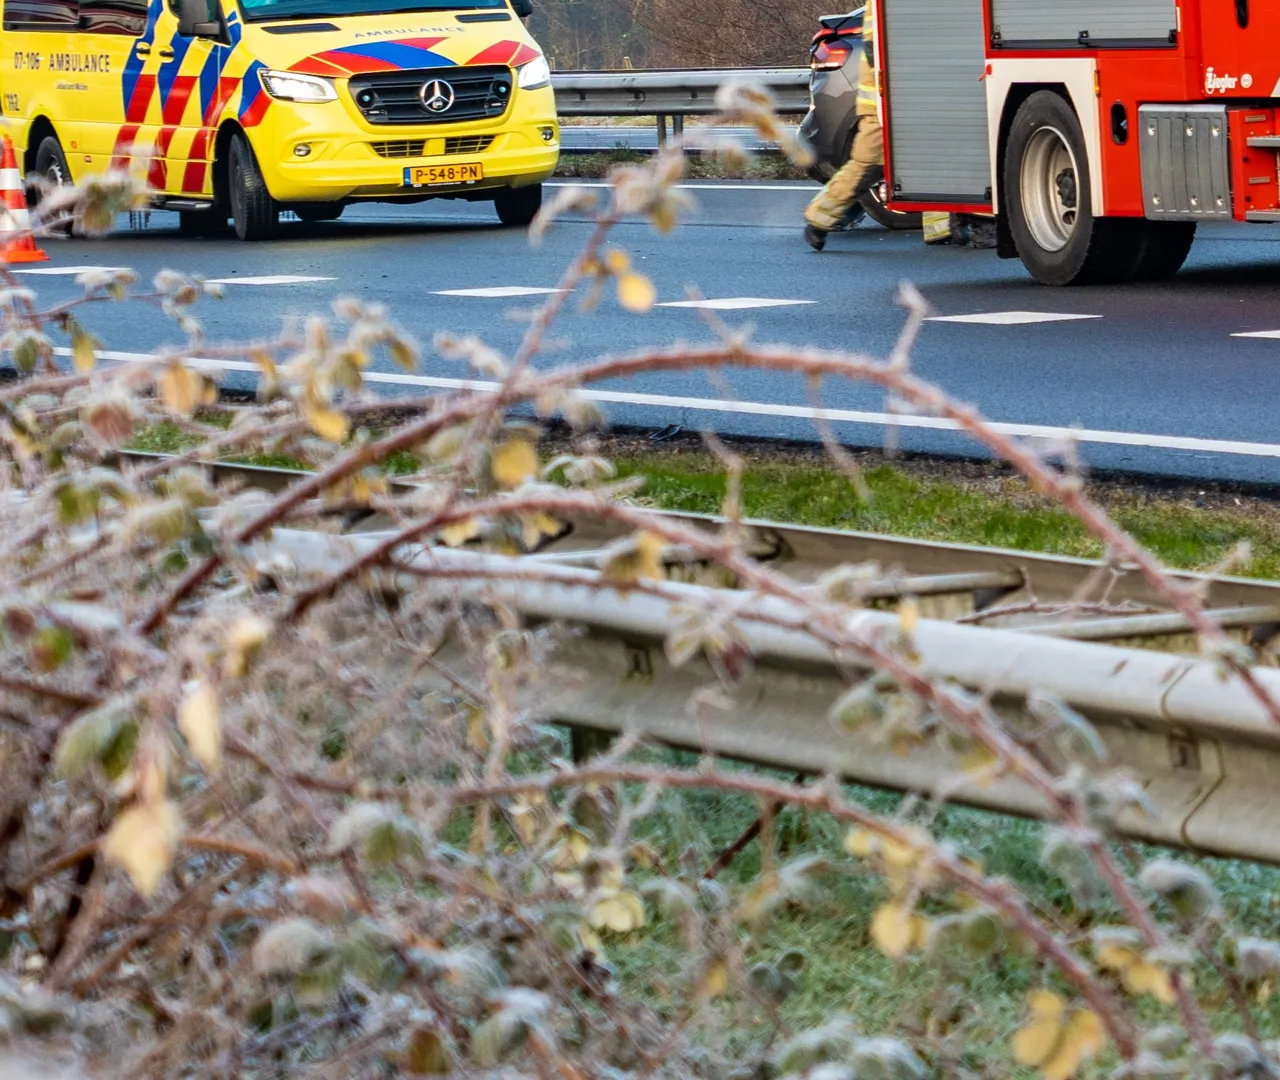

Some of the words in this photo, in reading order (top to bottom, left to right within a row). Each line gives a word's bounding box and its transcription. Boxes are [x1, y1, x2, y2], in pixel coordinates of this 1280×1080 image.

[354, 26, 466, 39] AMBULANCE
[14, 52, 41, 70] 07-106
[48, 53, 110, 73] AMBULANCE
[415, 166, 478, 182] P-548-PN
